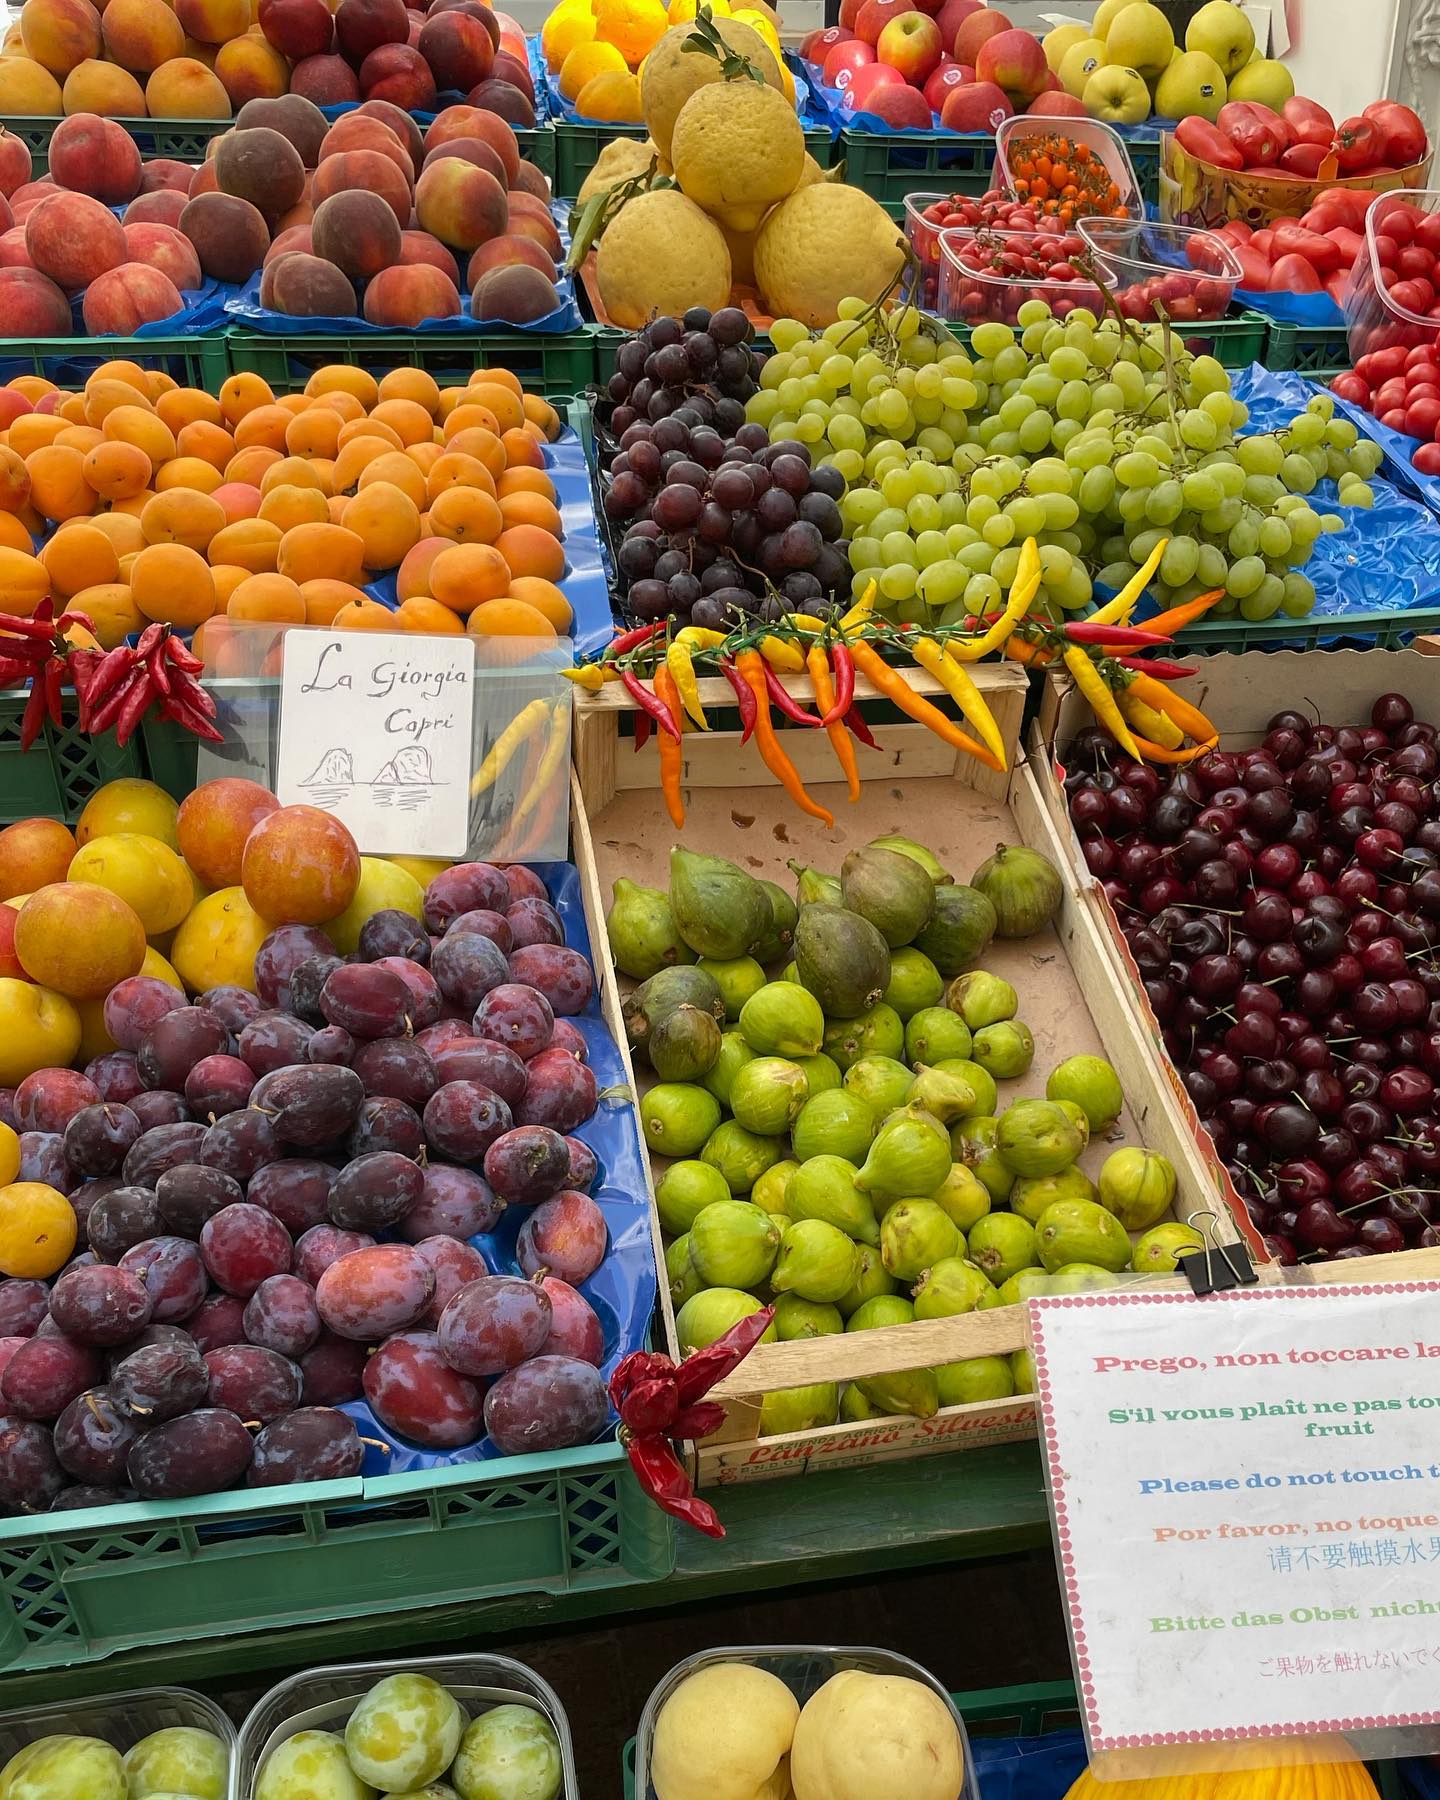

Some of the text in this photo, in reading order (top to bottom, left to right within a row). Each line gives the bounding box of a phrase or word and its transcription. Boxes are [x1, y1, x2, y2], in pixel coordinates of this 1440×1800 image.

[301, 643, 468, 700] La Giorgia
[384, 708, 455, 741] Capri
[1092, 1356, 1207, 1374] Prego,
[1214, 1350, 1282, 1367] non
[1286, 1347, 1410, 1363] toccare
[1108, 1407, 1156, 1424] S'il
[1161, 1407, 1234, 1421] vous
[1239, 1399, 1308, 1421] plaît
[1313, 1401, 1348, 1413] ne
[1352, 1399, 1402, 1415] pas
[775, 1422, 916, 1452] AZIENDA AGRICOLA
[1304, 1421, 1375, 1437] fruit
[1138, 1464, 1440, 1494] Please do not touch t
[1152, 1515, 1439, 1542] Por favor, no toque
[1149, 1616, 1226, 1632] Bitte
[1231, 1611, 1284, 1627] das
[1289, 1606, 1360, 1623] Obst
